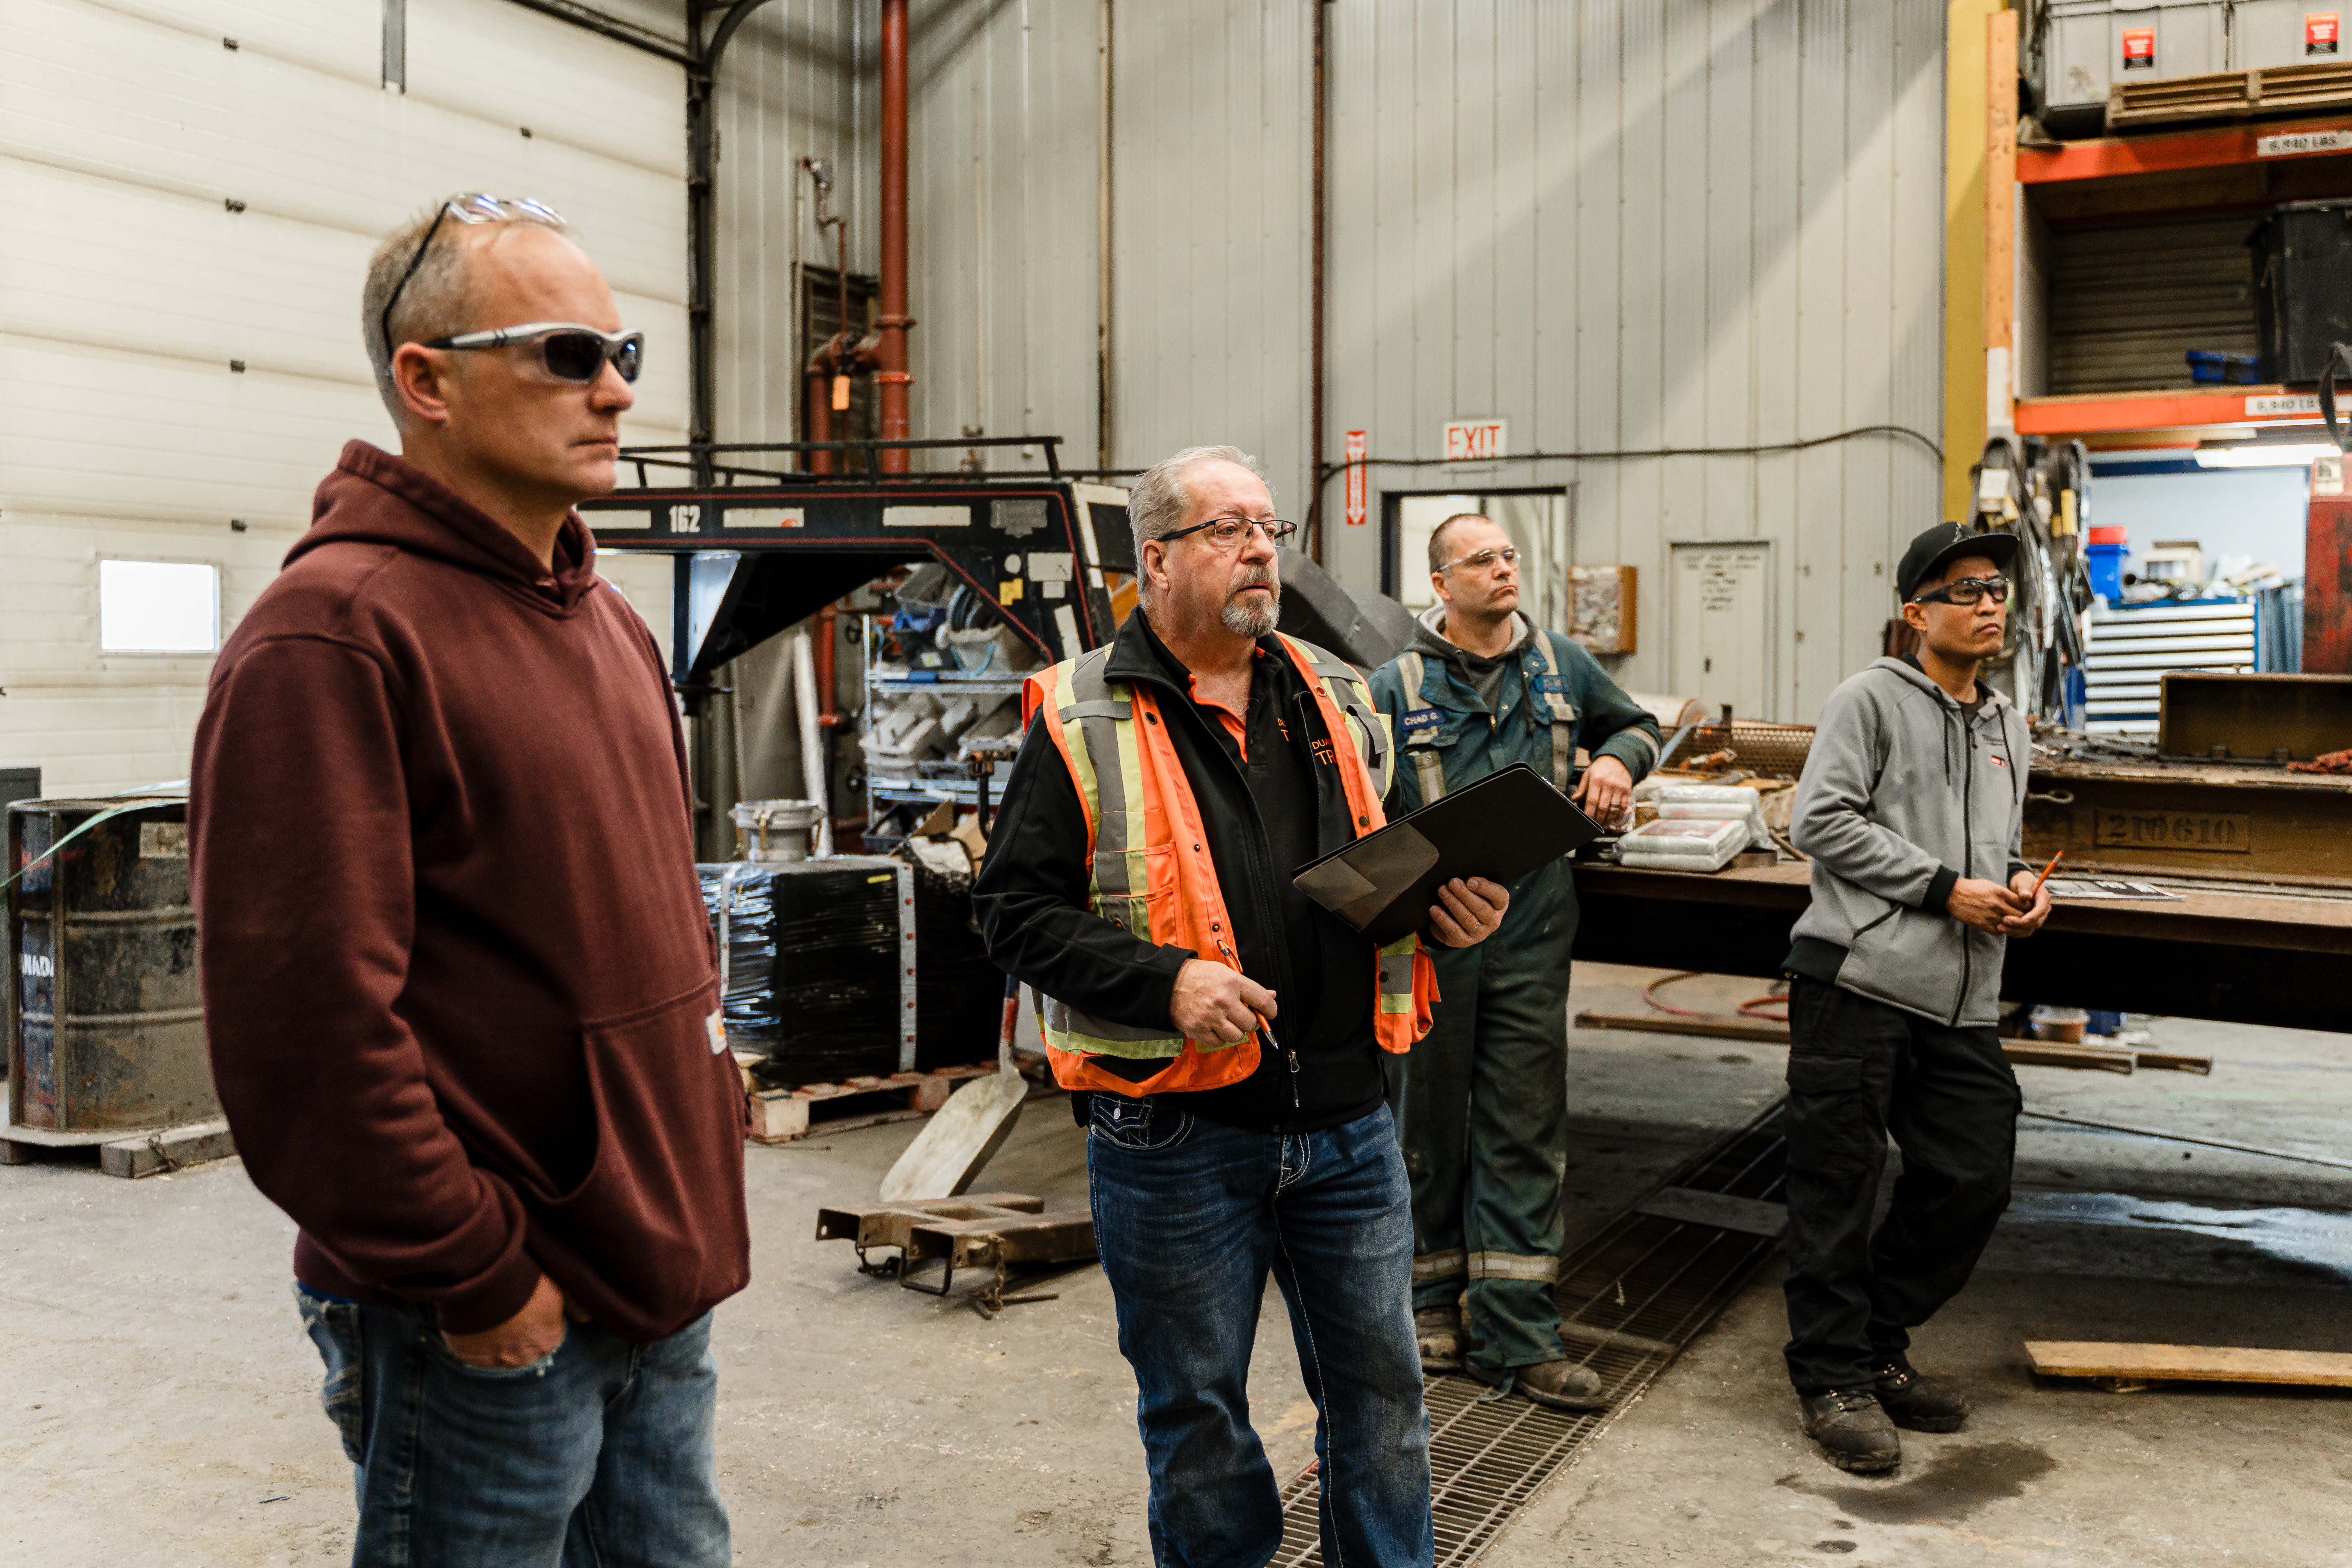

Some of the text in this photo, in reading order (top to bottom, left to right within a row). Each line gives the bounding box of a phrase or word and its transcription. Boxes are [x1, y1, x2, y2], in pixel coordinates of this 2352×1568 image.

[2312, 135, 2338, 147] LBS
[2300, 395, 2319, 409] LB
[1448, 425, 1501, 461] EXIT
[668, 505, 701, 533] 162
[1404, 714, 1428, 725] CHAD
